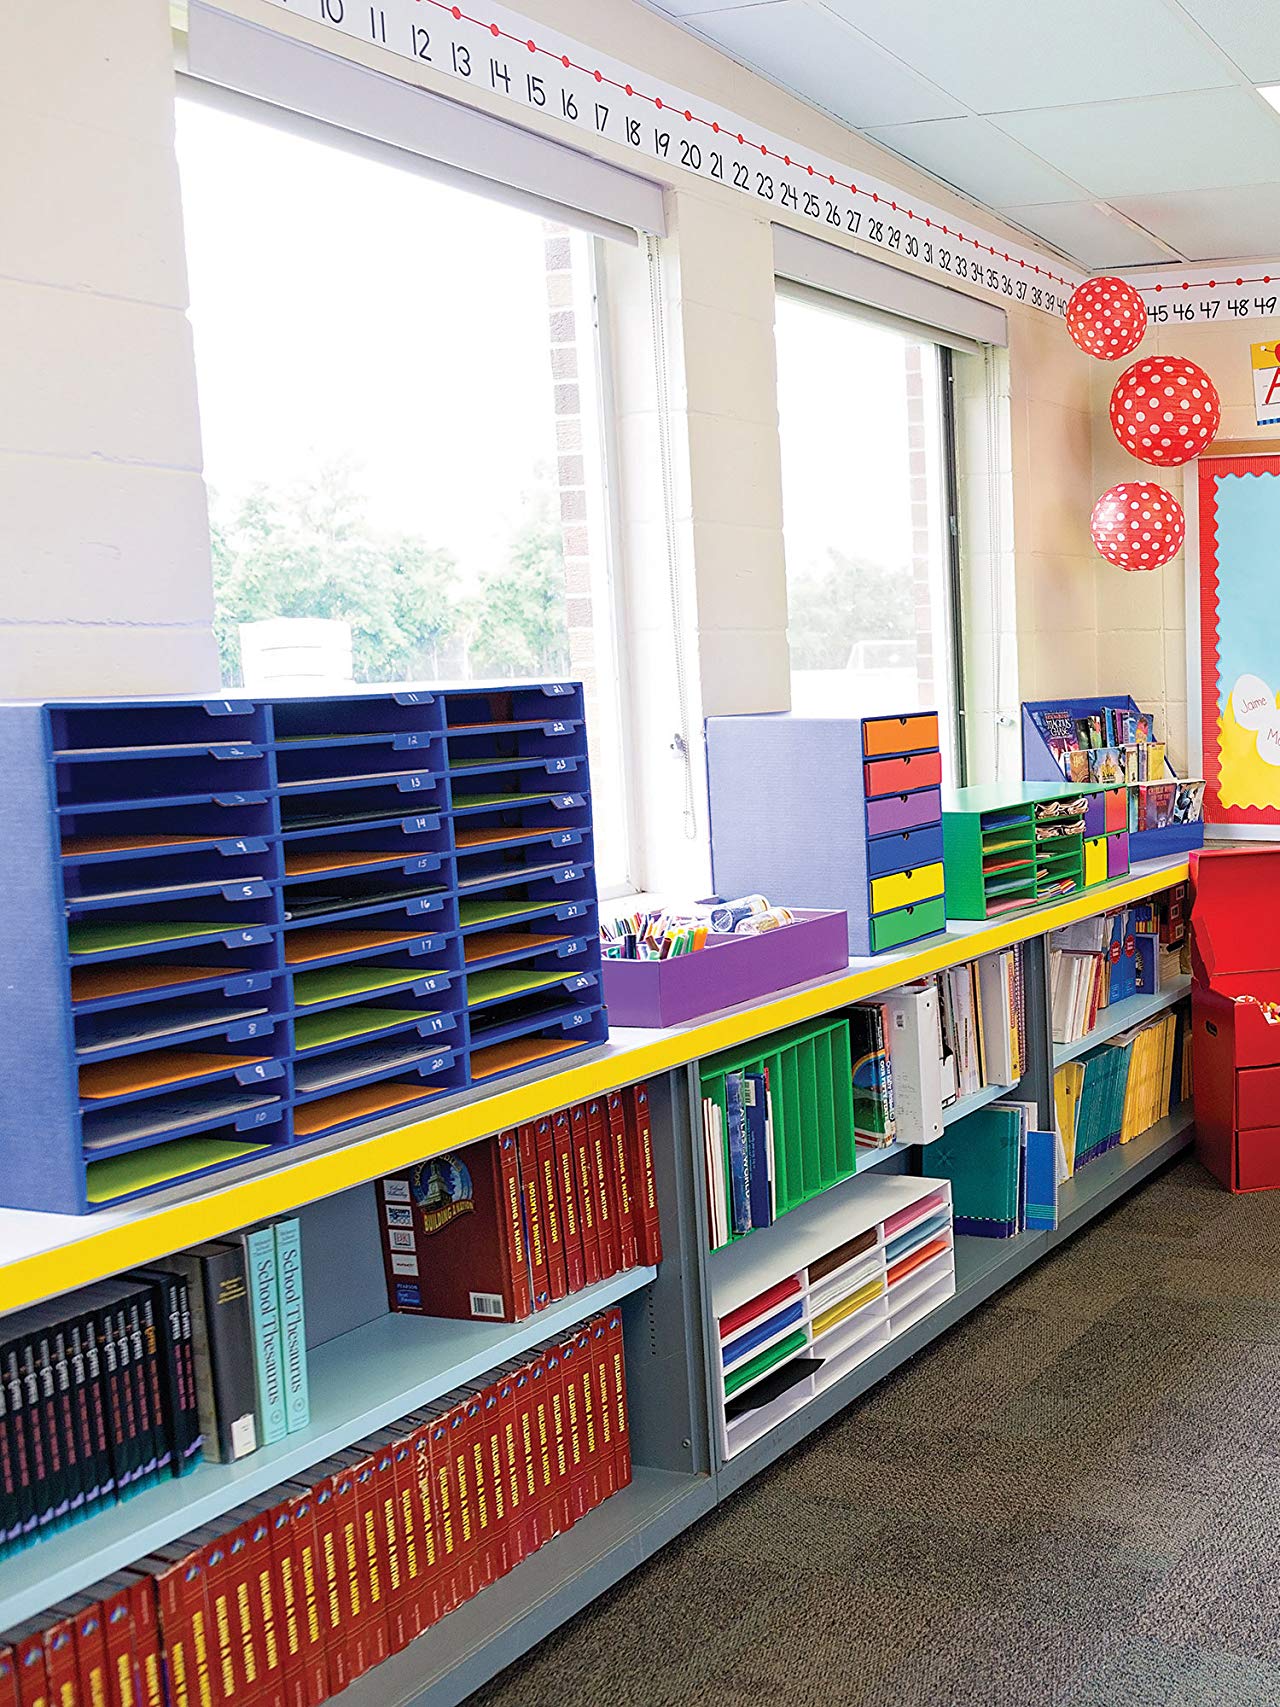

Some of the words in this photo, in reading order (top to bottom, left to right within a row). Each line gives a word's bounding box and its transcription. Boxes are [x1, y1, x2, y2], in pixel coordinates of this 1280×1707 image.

[320, 0, 344, 24] 10
[370, 6, 386, 43] 11
[411, 24, 432, 62] 12
[451, 42, 472, 77] 13
[526, 73, 546, 107] 15
[561, 88, 578, 120] 16
[625, 116, 641, 147] 18
[654, 128, 671, 157] 19
[709, 151, 723, 180] 21
[732, 161, 750, 191] 22
[779, 181, 799, 211] 24
[801, 191, 821, 219] 25
[846, 209, 862, 234] 27
[867, 217, 885, 243] 28
[904, 233, 919, 258] 30
[923, 242, 933, 264] 31
[954, 255, 969, 278] 33
[986, 268, 999, 290] 35
[1015, 280, 1028, 301] 37
[1031, 286, 1043, 307] 38
[1146, 304, 1169, 323] 45
[1173, 303, 1195, 321] 46
[1227, 298, 1250, 317] 48
[1254, 296, 1278, 315] 49
[552, 685, 564, 693] 21
[1240, 693, 1268, 715] Jaime
[407, 735, 418, 746] 12
[555, 759, 566, 769] 23
[410, 777, 421, 788] 13
[236, 840, 247, 853] 4
[417, 859, 428, 869] 15
[564, 869, 576, 880] 26
[242, 885, 253, 896] 5
[567, 905, 578, 916] 27
[421, 939, 432, 950] 17
[576, 977, 588, 987] 29
[248, 1023, 256, 1035] 8
[431, 1018, 443, 1030] 19
[255, 1065, 265, 1078] 9
[431, 1058, 444, 1069] 20
[643, 1129, 652, 1168] BUILDING
[595, 1140, 604, 1180] BUILDING
[600, 1189, 608, 1221] NATION
[528, 1181, 538, 1214] NATION
[544, 1160, 554, 1201] BUILDING
[549, 1211, 558, 1243] NATION
[509, 1177, 519, 1220] BUILDING
[514, 1229, 522, 1263] NATION
[533, 1224, 542, 1266] BUILDING
[257, 1259, 277, 1315] School
[283, 1249, 301, 1304] School
[262, 1315, 279, 1406] Thesaurus
[286, 1304, 303, 1394] Thesaurus
[614, 1354, 623, 1396] BUILDING
[583, 1373, 592, 1413] BUILDING
[617, 1402, 625, 1433] NATION
[587, 1421, 595, 1453] NATION
[365, 1510, 377, 1557] BUILDING
[368, 1558, 377, 1567] A
[369, 1566, 381, 1603] NATION
